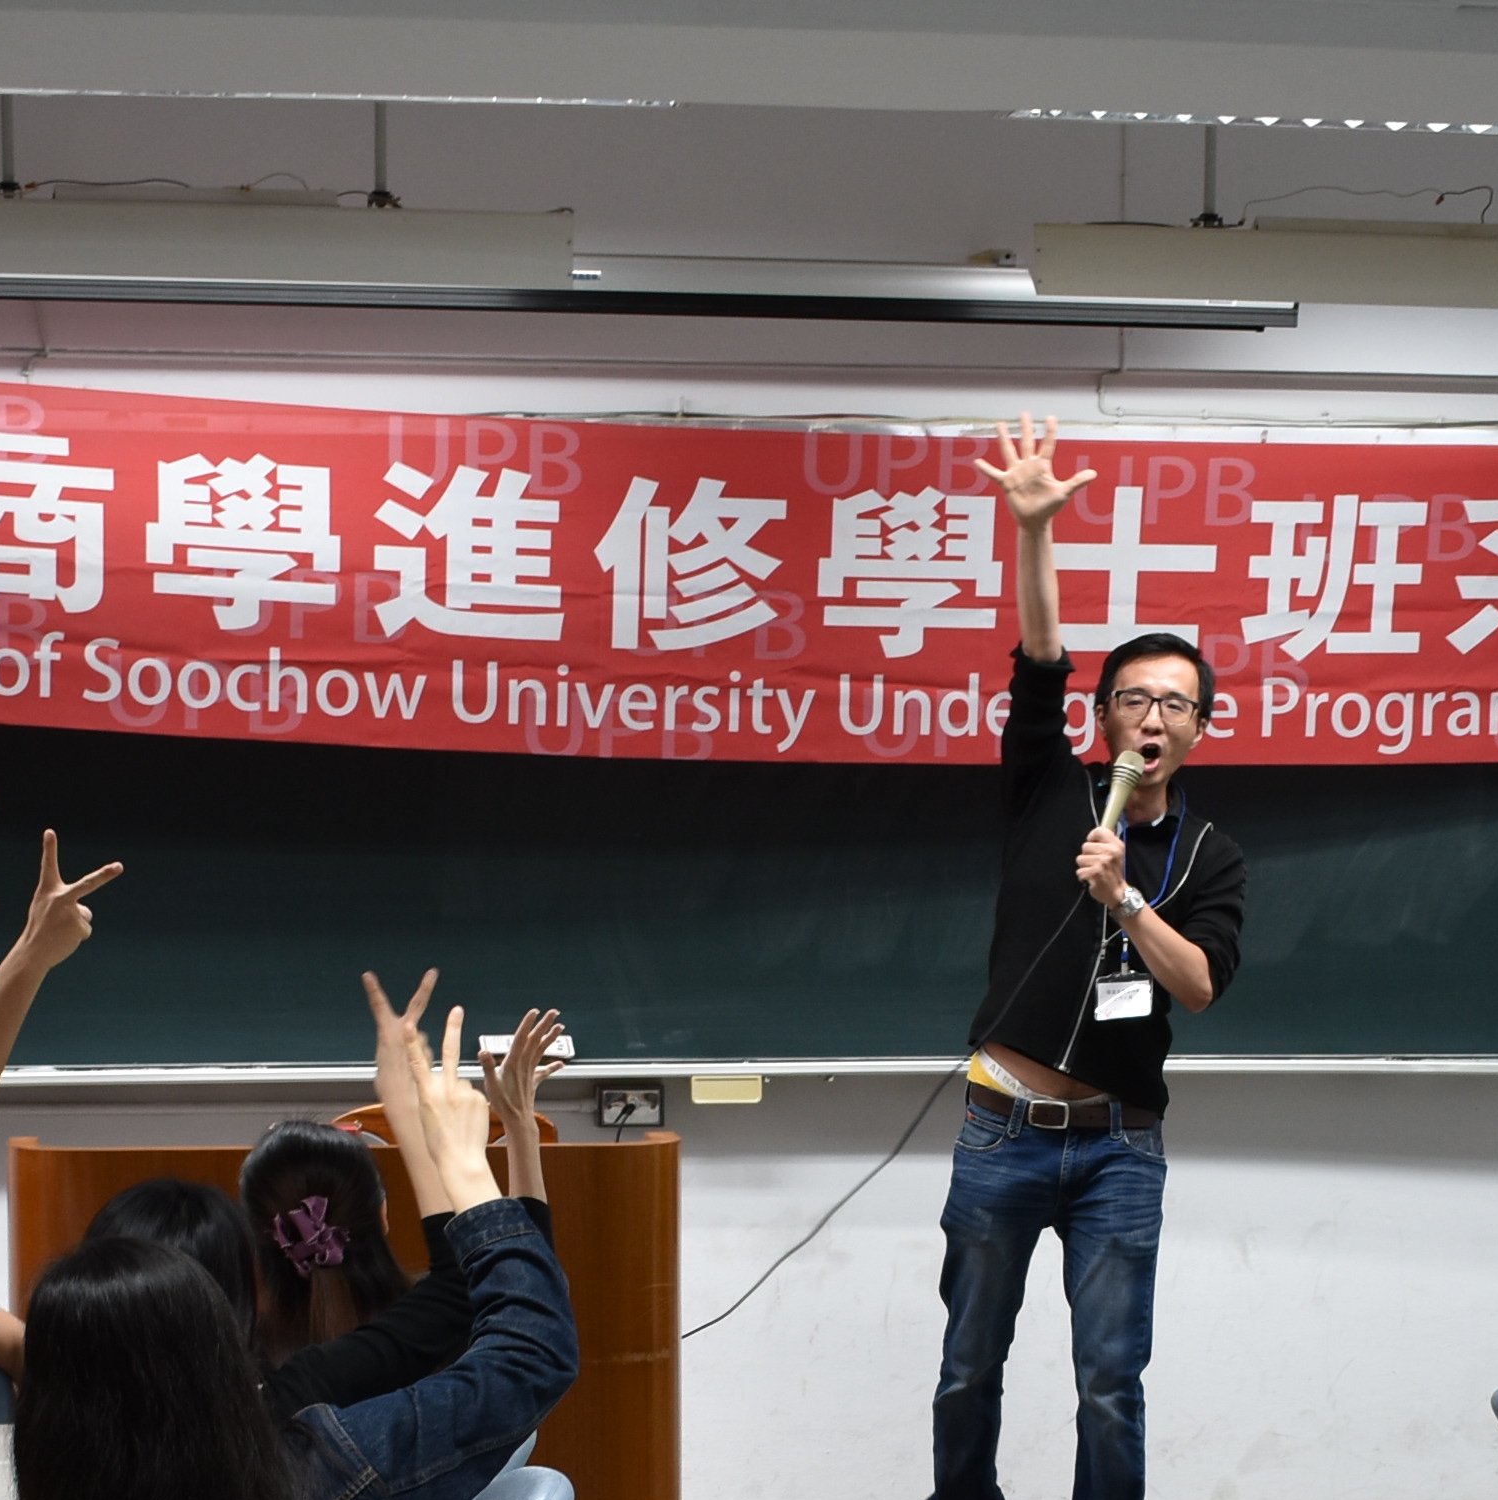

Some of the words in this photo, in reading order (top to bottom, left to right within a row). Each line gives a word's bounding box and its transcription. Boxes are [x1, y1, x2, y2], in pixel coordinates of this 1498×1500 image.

[387, 415, 582, 497] UPB
[1075, 454, 1256, 526] UPB
[82, 637, 427, 720] Soochow
[451, 658, 816, 753] University
[863, 687, 1001, 758] UP
